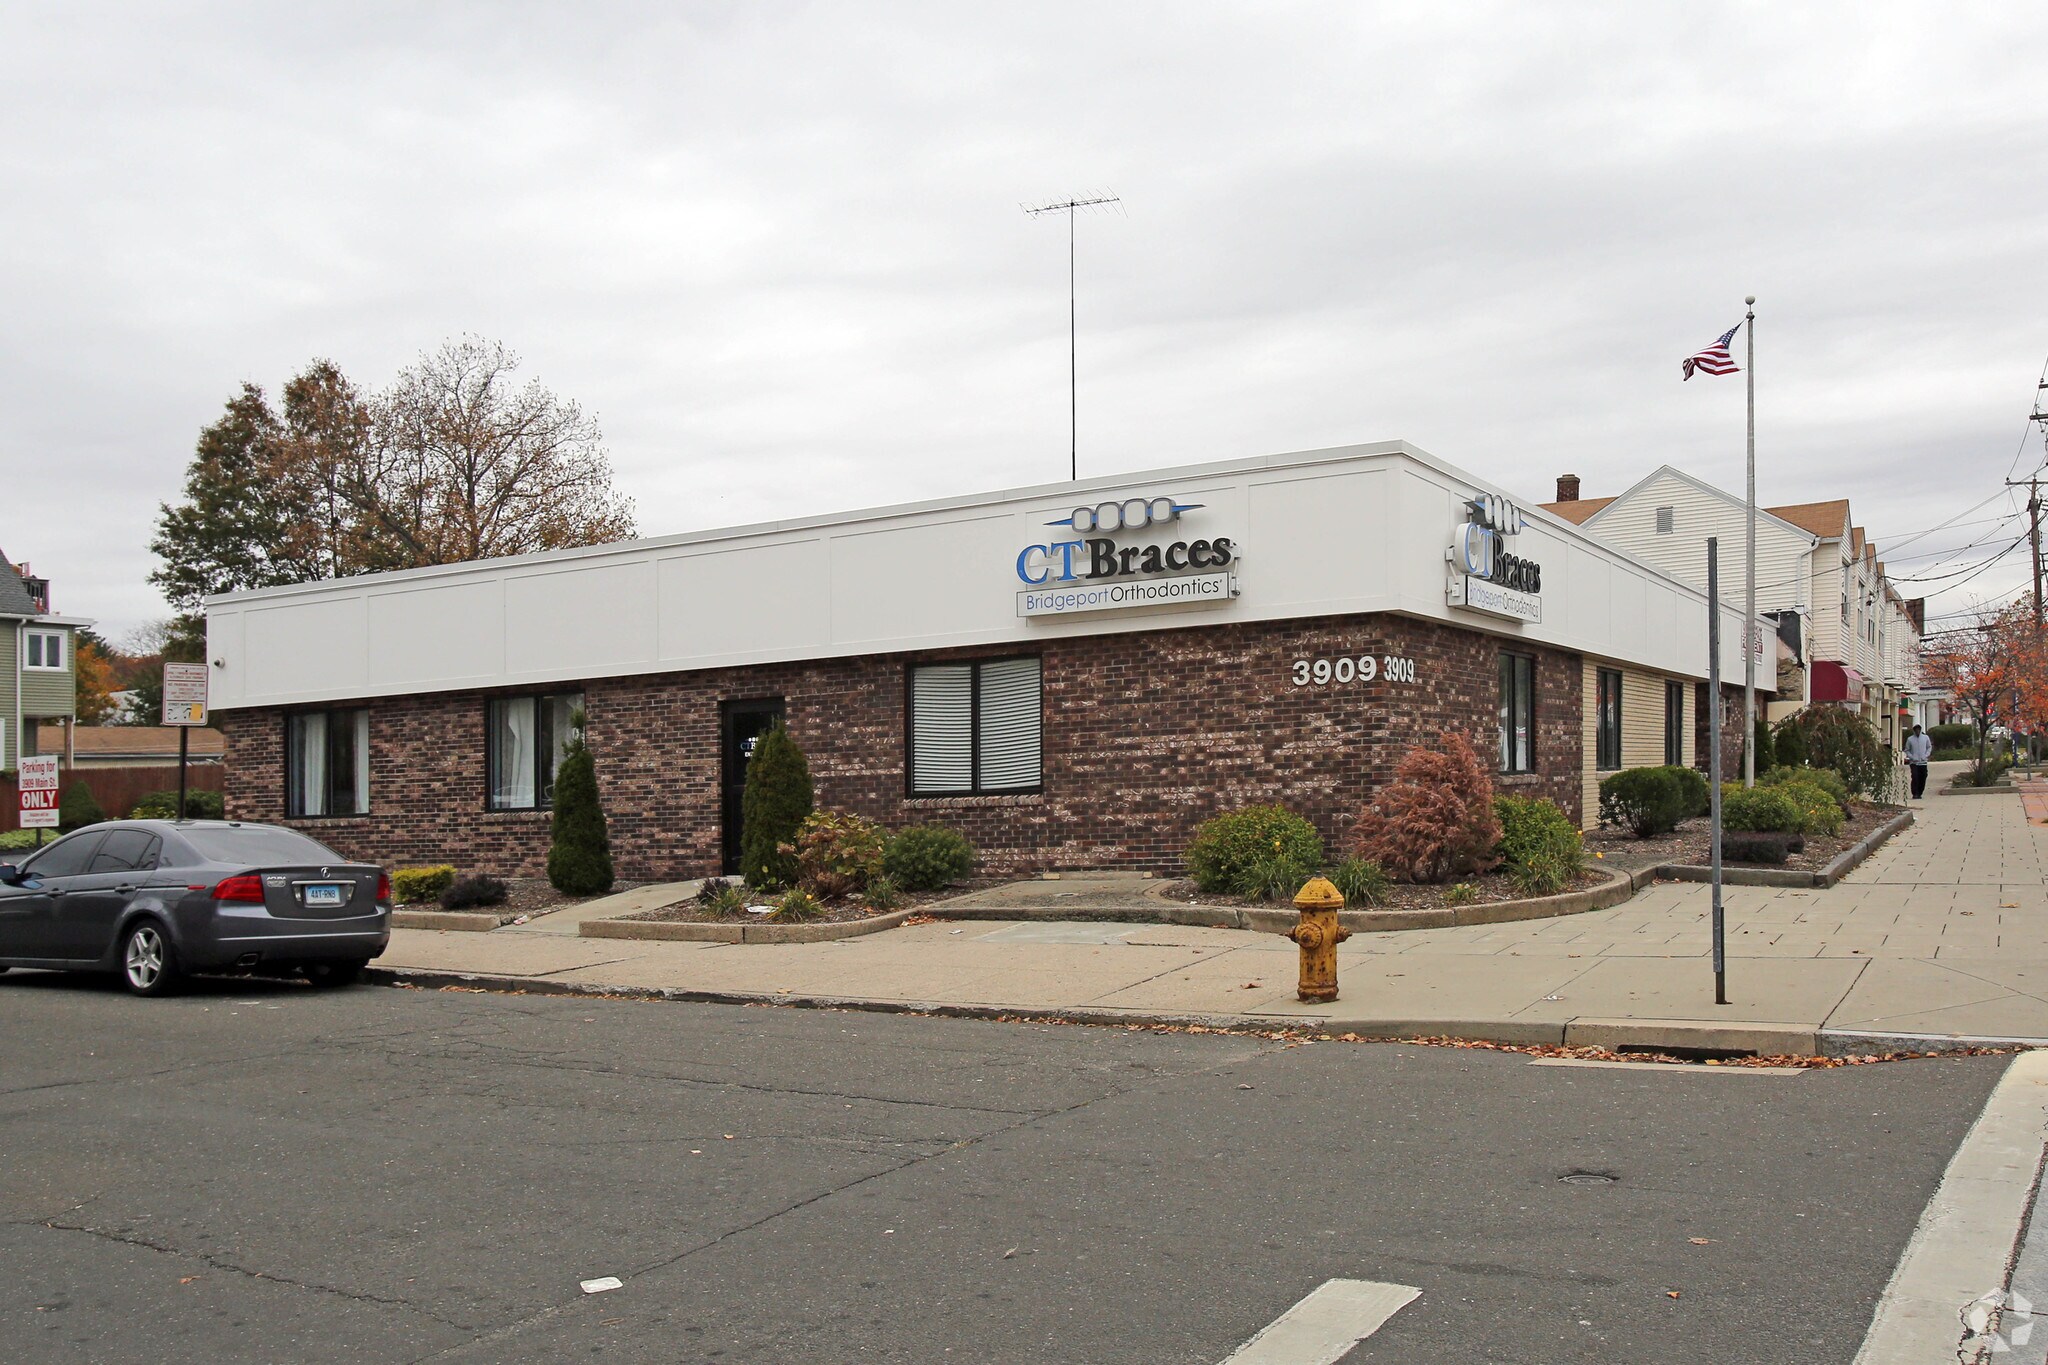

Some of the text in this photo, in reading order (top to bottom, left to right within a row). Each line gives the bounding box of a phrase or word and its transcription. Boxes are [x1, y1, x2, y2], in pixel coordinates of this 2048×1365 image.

[1292, 656, 1377, 686] 3909
[1384, 655, 1414, 683] 3909
[22, 761, 55, 775] Parking for
[35, 778, 48, 787] Main
[22, 790, 56, 808] ONLY
